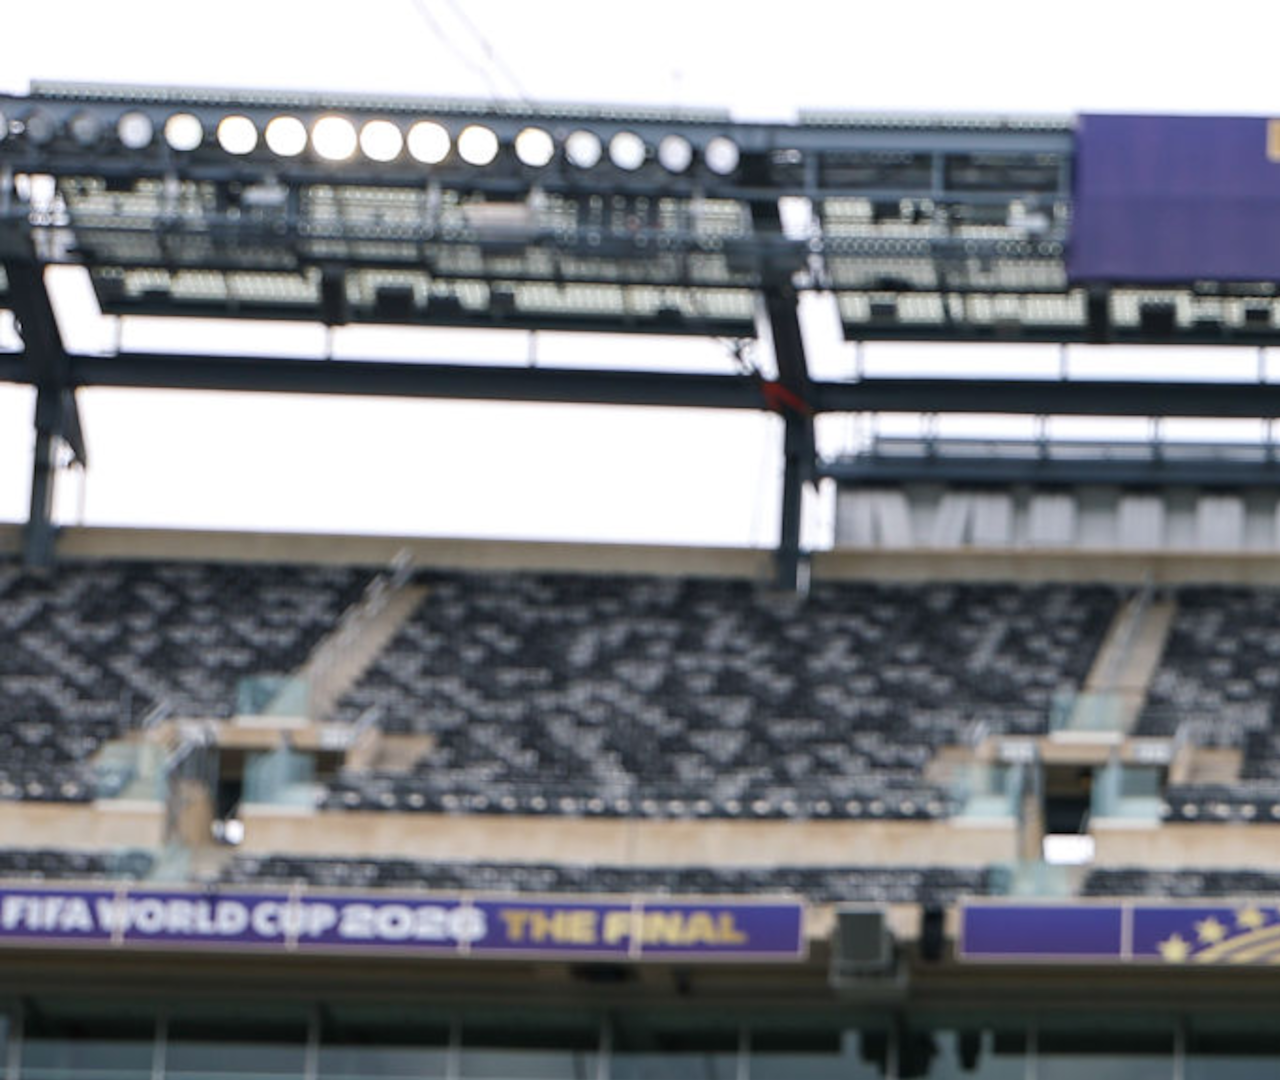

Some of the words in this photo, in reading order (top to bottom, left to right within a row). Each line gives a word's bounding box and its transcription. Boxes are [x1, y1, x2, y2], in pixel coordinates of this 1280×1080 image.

[2, 894, 91, 933] FIFA
[97, 897, 247, 937] WORLD
[252, 901, 335, 938] CUP
[338, 903, 487, 943] 2026
[499, 908, 597, 944] THE
[603, 911, 748, 946] FINAL
